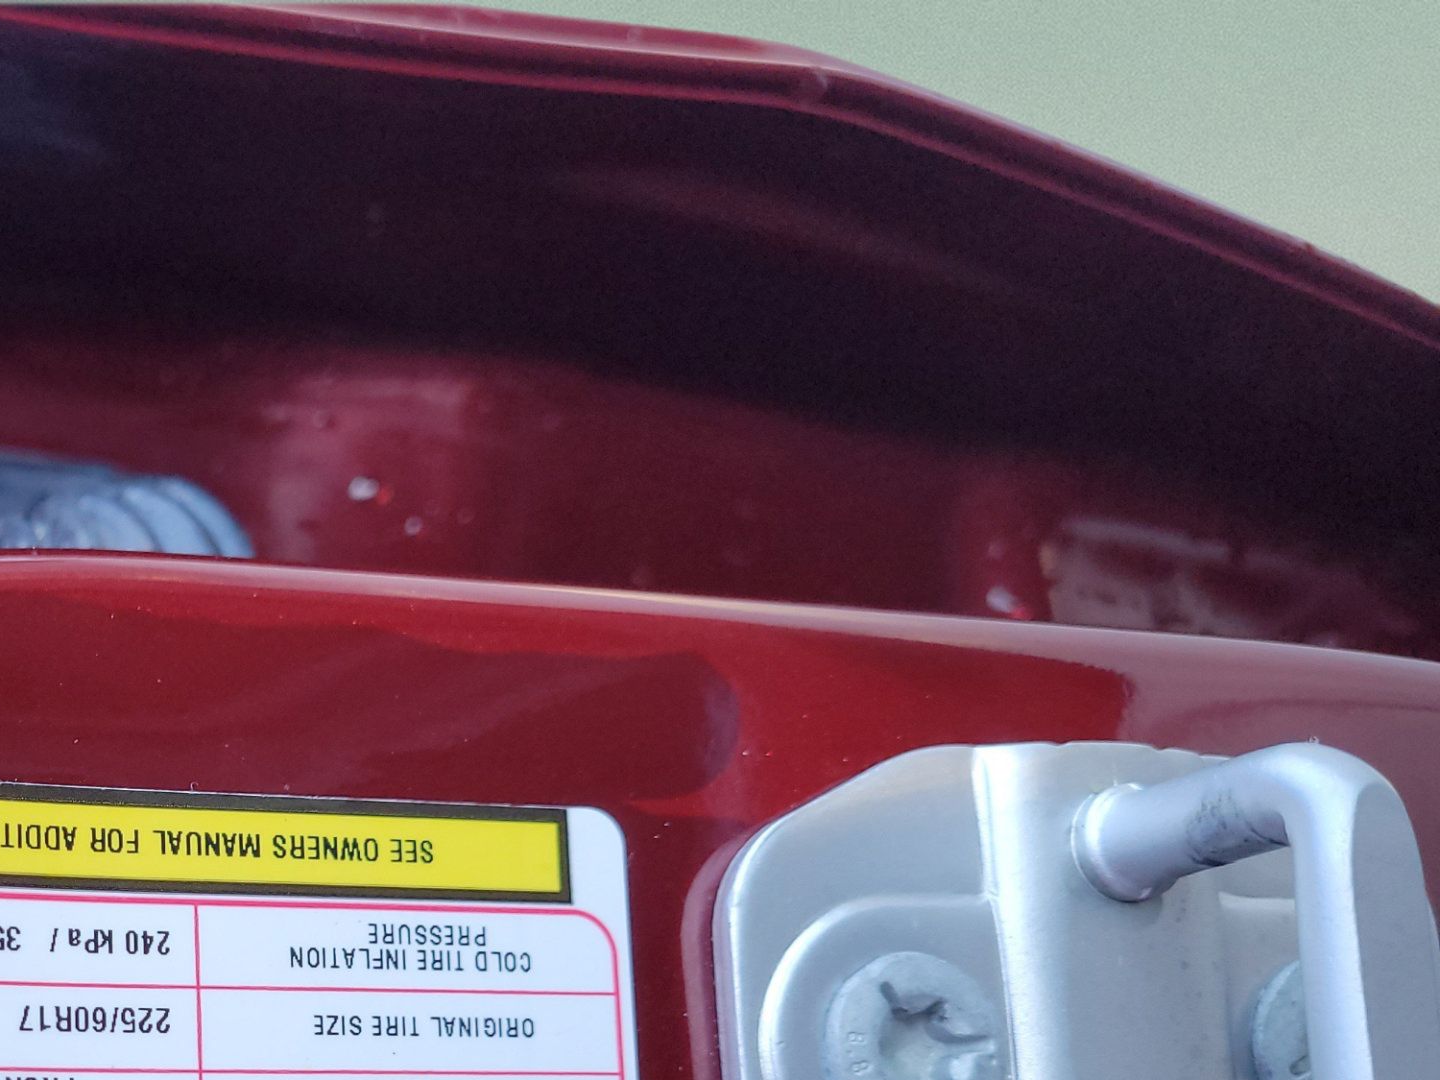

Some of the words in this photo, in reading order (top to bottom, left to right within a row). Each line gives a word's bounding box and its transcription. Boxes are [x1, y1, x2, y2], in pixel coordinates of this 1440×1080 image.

[90, 827, 139, 854] FOR
[152, 830, 261, 858] MANUAL
[272, 834, 379, 862] OWNERS
[390, 838, 434, 864] SEE
[125, 930, 170, 956] 240
[368, 923, 487, 947] PRESSURE
[290, 946, 407, 971] INFLATION
[417, 949, 464, 972] TIRE
[474, 950, 531, 973] COLD
[19, 1005, 171, 1034] 225/60R17
[313, 1014, 362, 1036] SIZE
[372, 1015, 420, 1037] TIRE
[430, 1016, 535, 1038] ORIGINAL
